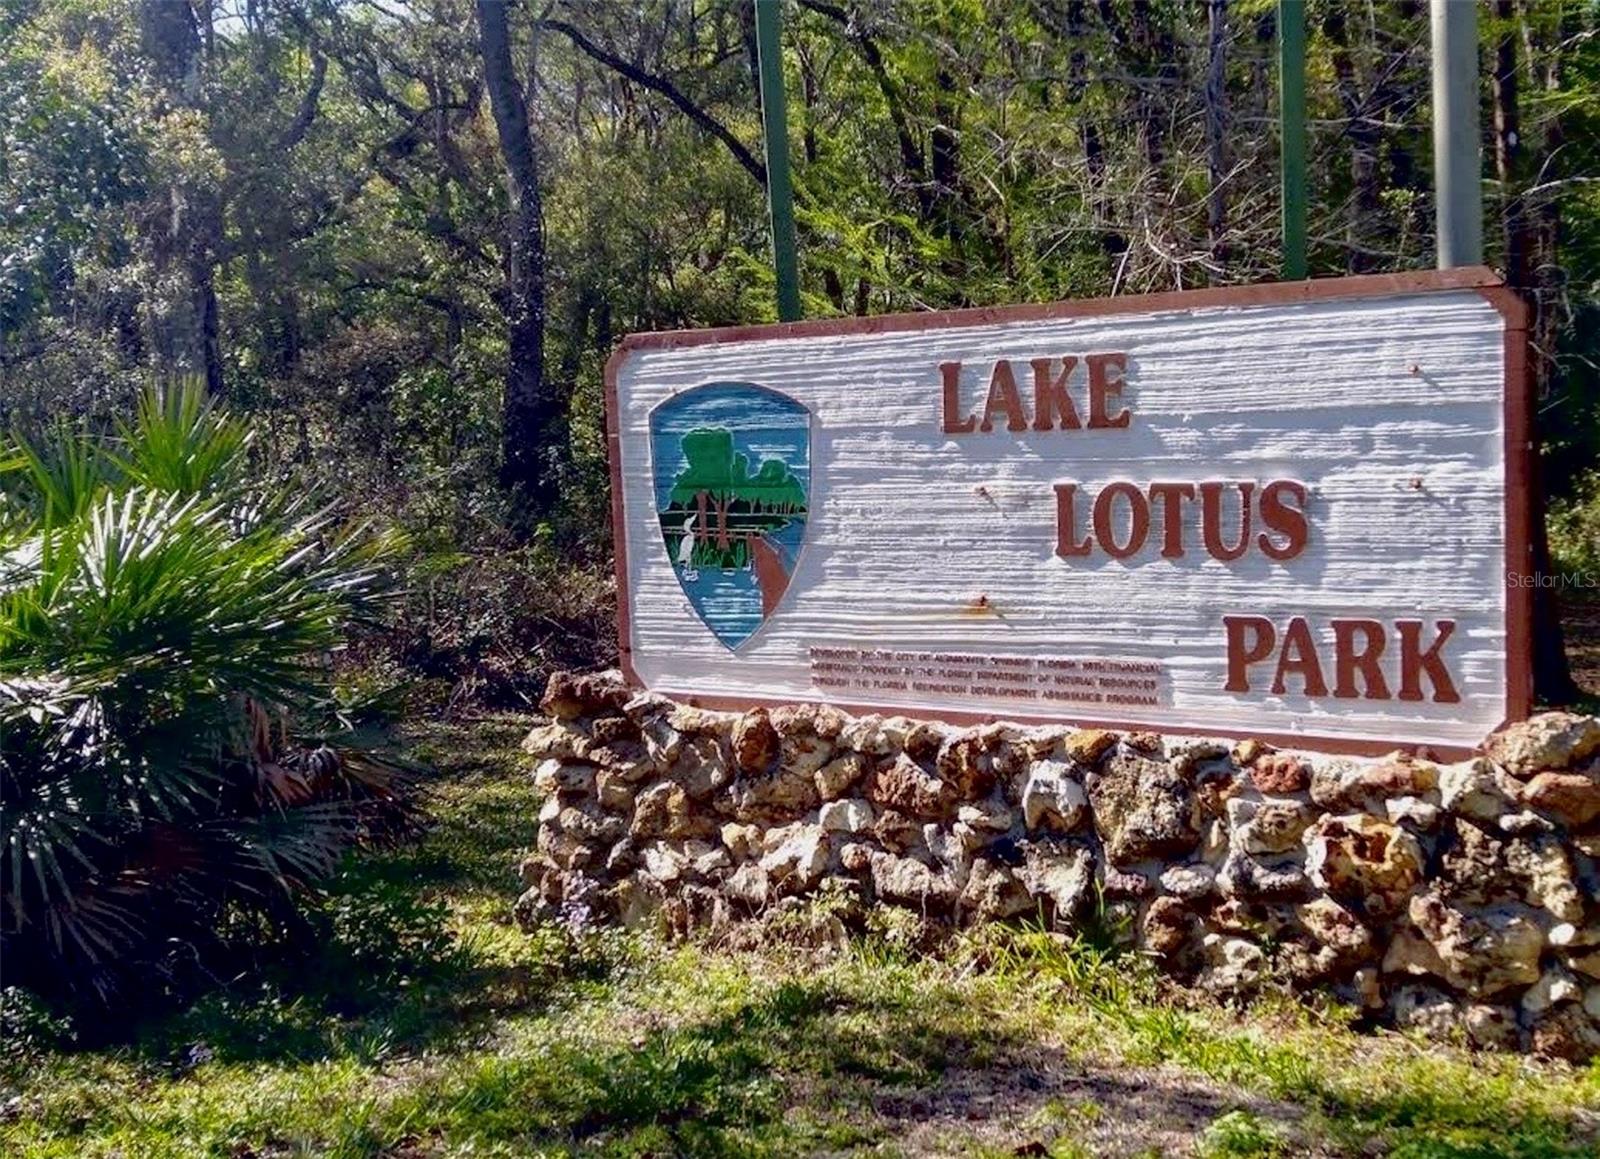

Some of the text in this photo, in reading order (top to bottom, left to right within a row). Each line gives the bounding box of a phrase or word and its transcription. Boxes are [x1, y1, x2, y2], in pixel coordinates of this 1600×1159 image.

[939, 352, 1131, 433] LAKE
[1053, 480, 1310, 561] LOTUS
[876, 650, 892, 661] THE
[896, 651, 915, 662] CITY
[1038, 659, 1076, 670] FLORIDA
[1082, 661, 1105, 672] WITH
[1108, 662, 1161, 674] FINANCIAL
[918, 667, 934, 677] THE
[938, 668, 973, 679] FLORIDA
[977, 671, 1032, 683] DEPARTMENT
[1038, 673, 1049, 683] OF
[1055, 675, 1096, 687] NATURAL
[1099, 677, 1157, 690] RESOURCES
[1223, 614, 1461, 704] PARK
[855, 678, 869, 688] THE
[873, 679, 907, 690] FLORIDA
[912, 682, 966, 694] RECREATION
[971, 685, 1036, 698] DEVELOPMENT
[1042, 690, 1102, 702] ASSISTANCE
[1106, 693, 1158, 705] PROGRAM
